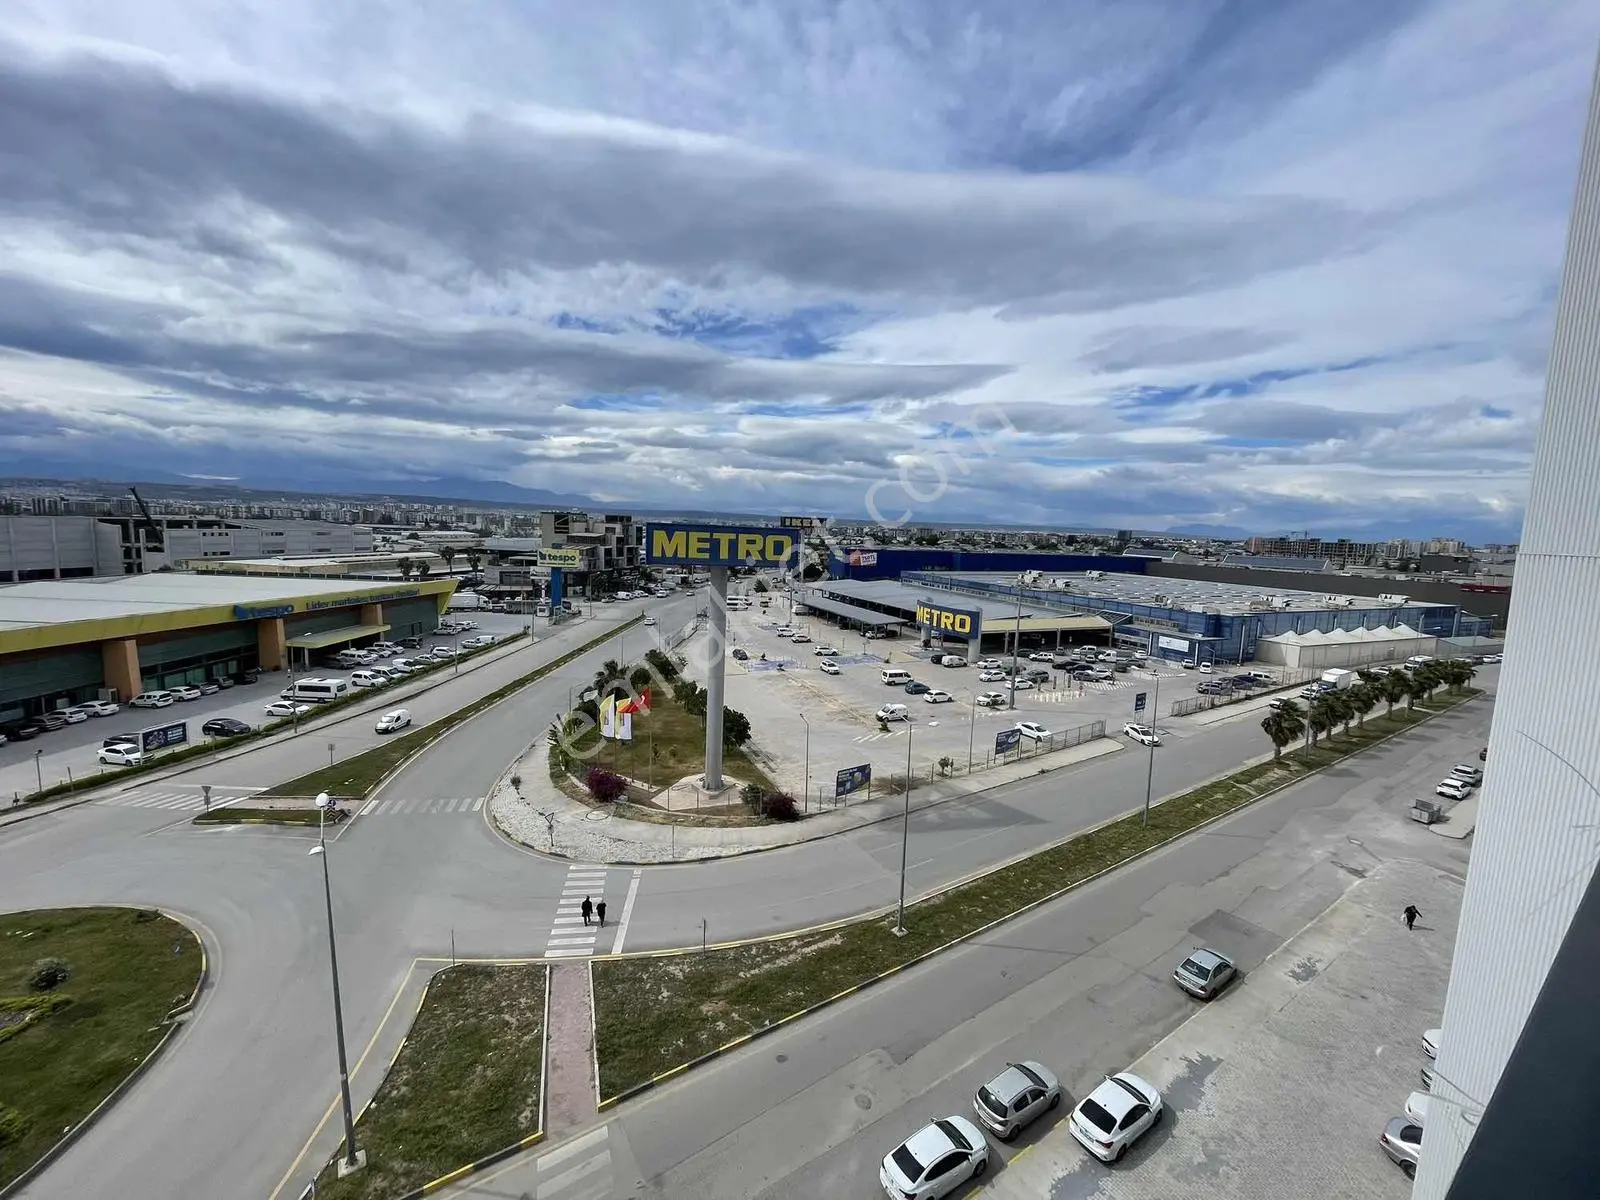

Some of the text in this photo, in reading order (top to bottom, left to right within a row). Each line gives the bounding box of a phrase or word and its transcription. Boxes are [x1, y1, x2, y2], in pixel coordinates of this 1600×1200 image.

[548, 553, 577, 563] tespo
[653, 529, 792, 561] METRO
[915, 604, 972, 634] METRO
